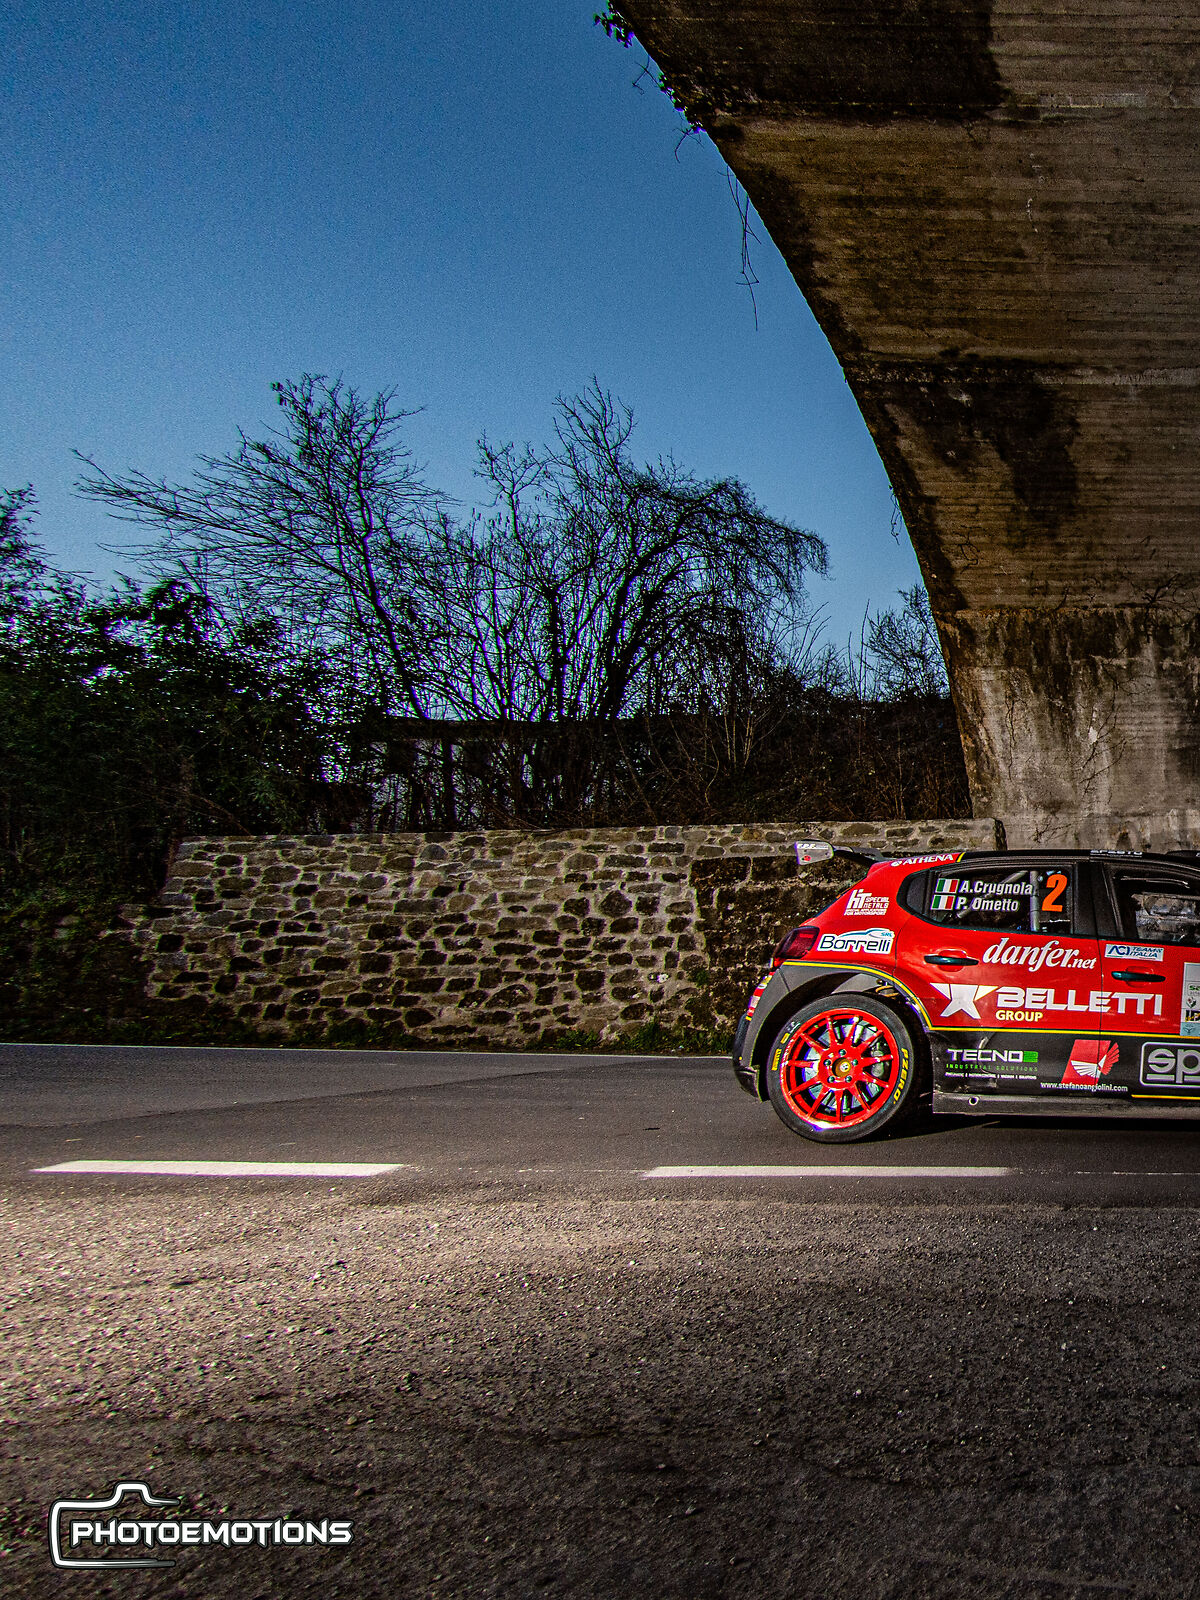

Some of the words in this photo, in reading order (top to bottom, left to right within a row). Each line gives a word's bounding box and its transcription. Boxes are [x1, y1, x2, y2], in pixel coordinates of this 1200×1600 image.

[902, 854, 954, 866] ATHENA
[958, 880, 1033, 896] A.Crugnola
[1041, 873, 1068, 912] 2
[956, 897, 968, 910] P.
[972, 897, 1019, 912] Ometto
[820, 936, 891, 952] Borrelli
[982, 937, 1096, 973] danfer.net
[995, 986, 1163, 1016] BELLETTI
[995, 1010, 1044, 1022] GROUP
[947, 1048, 1023, 1063] TECNO
